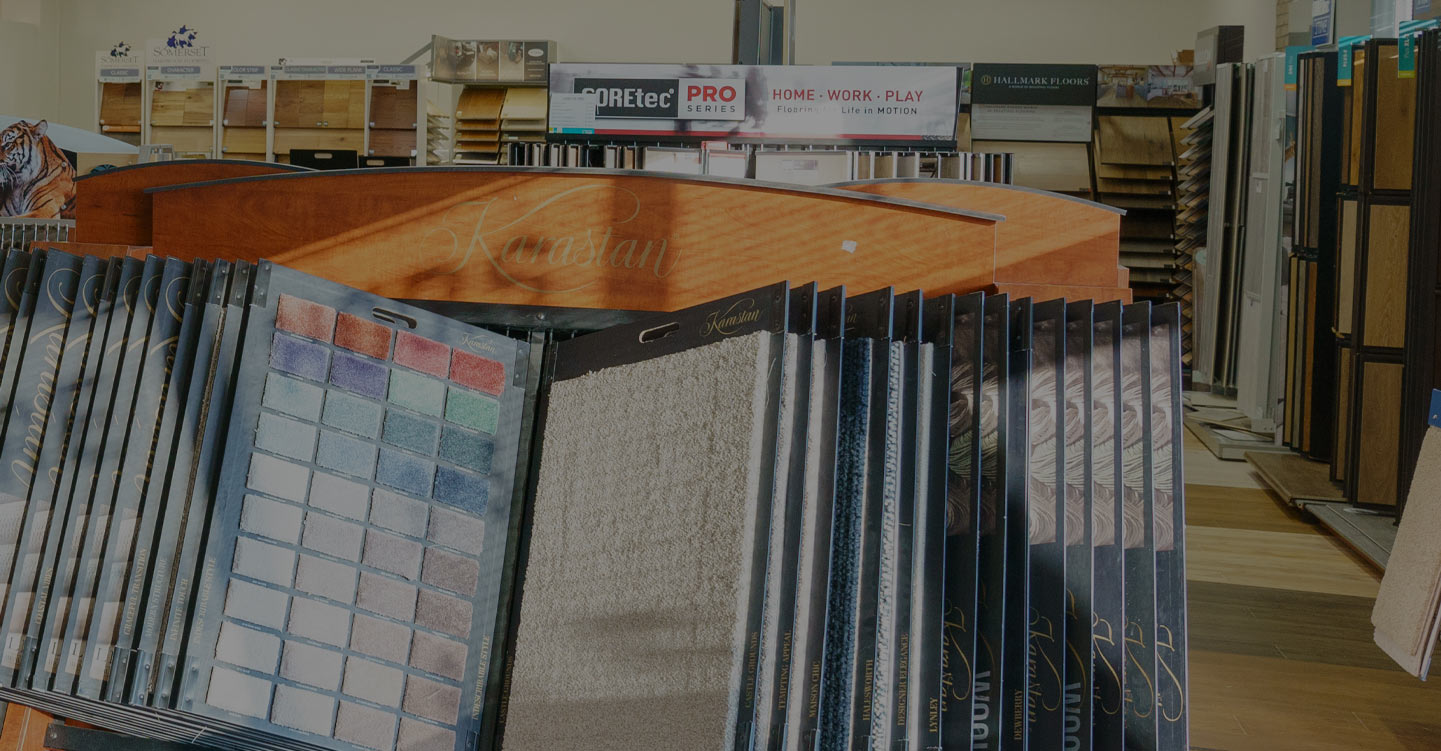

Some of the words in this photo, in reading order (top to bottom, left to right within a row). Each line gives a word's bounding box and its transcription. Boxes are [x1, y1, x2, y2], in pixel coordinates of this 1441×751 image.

[153, 47, 209, 57] SOMERSET
[687, 86, 737, 102] PRO
[773, 89, 815, 101] HOME
[827, 90, 873, 101] WORK
[886, 90, 924, 102] PLAY
[993, 76, 1048, 85] HALLMARK
[1050, 77, 1089, 86] FLOORS
[687, 104, 736, 113] SERIES
[841, 106, 861, 114] Life
[864, 106, 873, 114] in
[877, 107, 918, 115] MOTION
[421, 185, 682, 294] Karastan
[699, 298, 761, 337] Karastan
[782, 629, 792, 663] APPEAL
[777, 664, 789, 711] TEMPTING
[811, 660, 821, 684] CHIC
[745, 675, 755, 709] CASTLE
[808, 684, 819, 718] MAISON
[862, 659, 874, 721] HALESWORTH
[928, 696, 939, 733] LYNLEY
[1013, 688, 1023, 741] DEWBERRY
